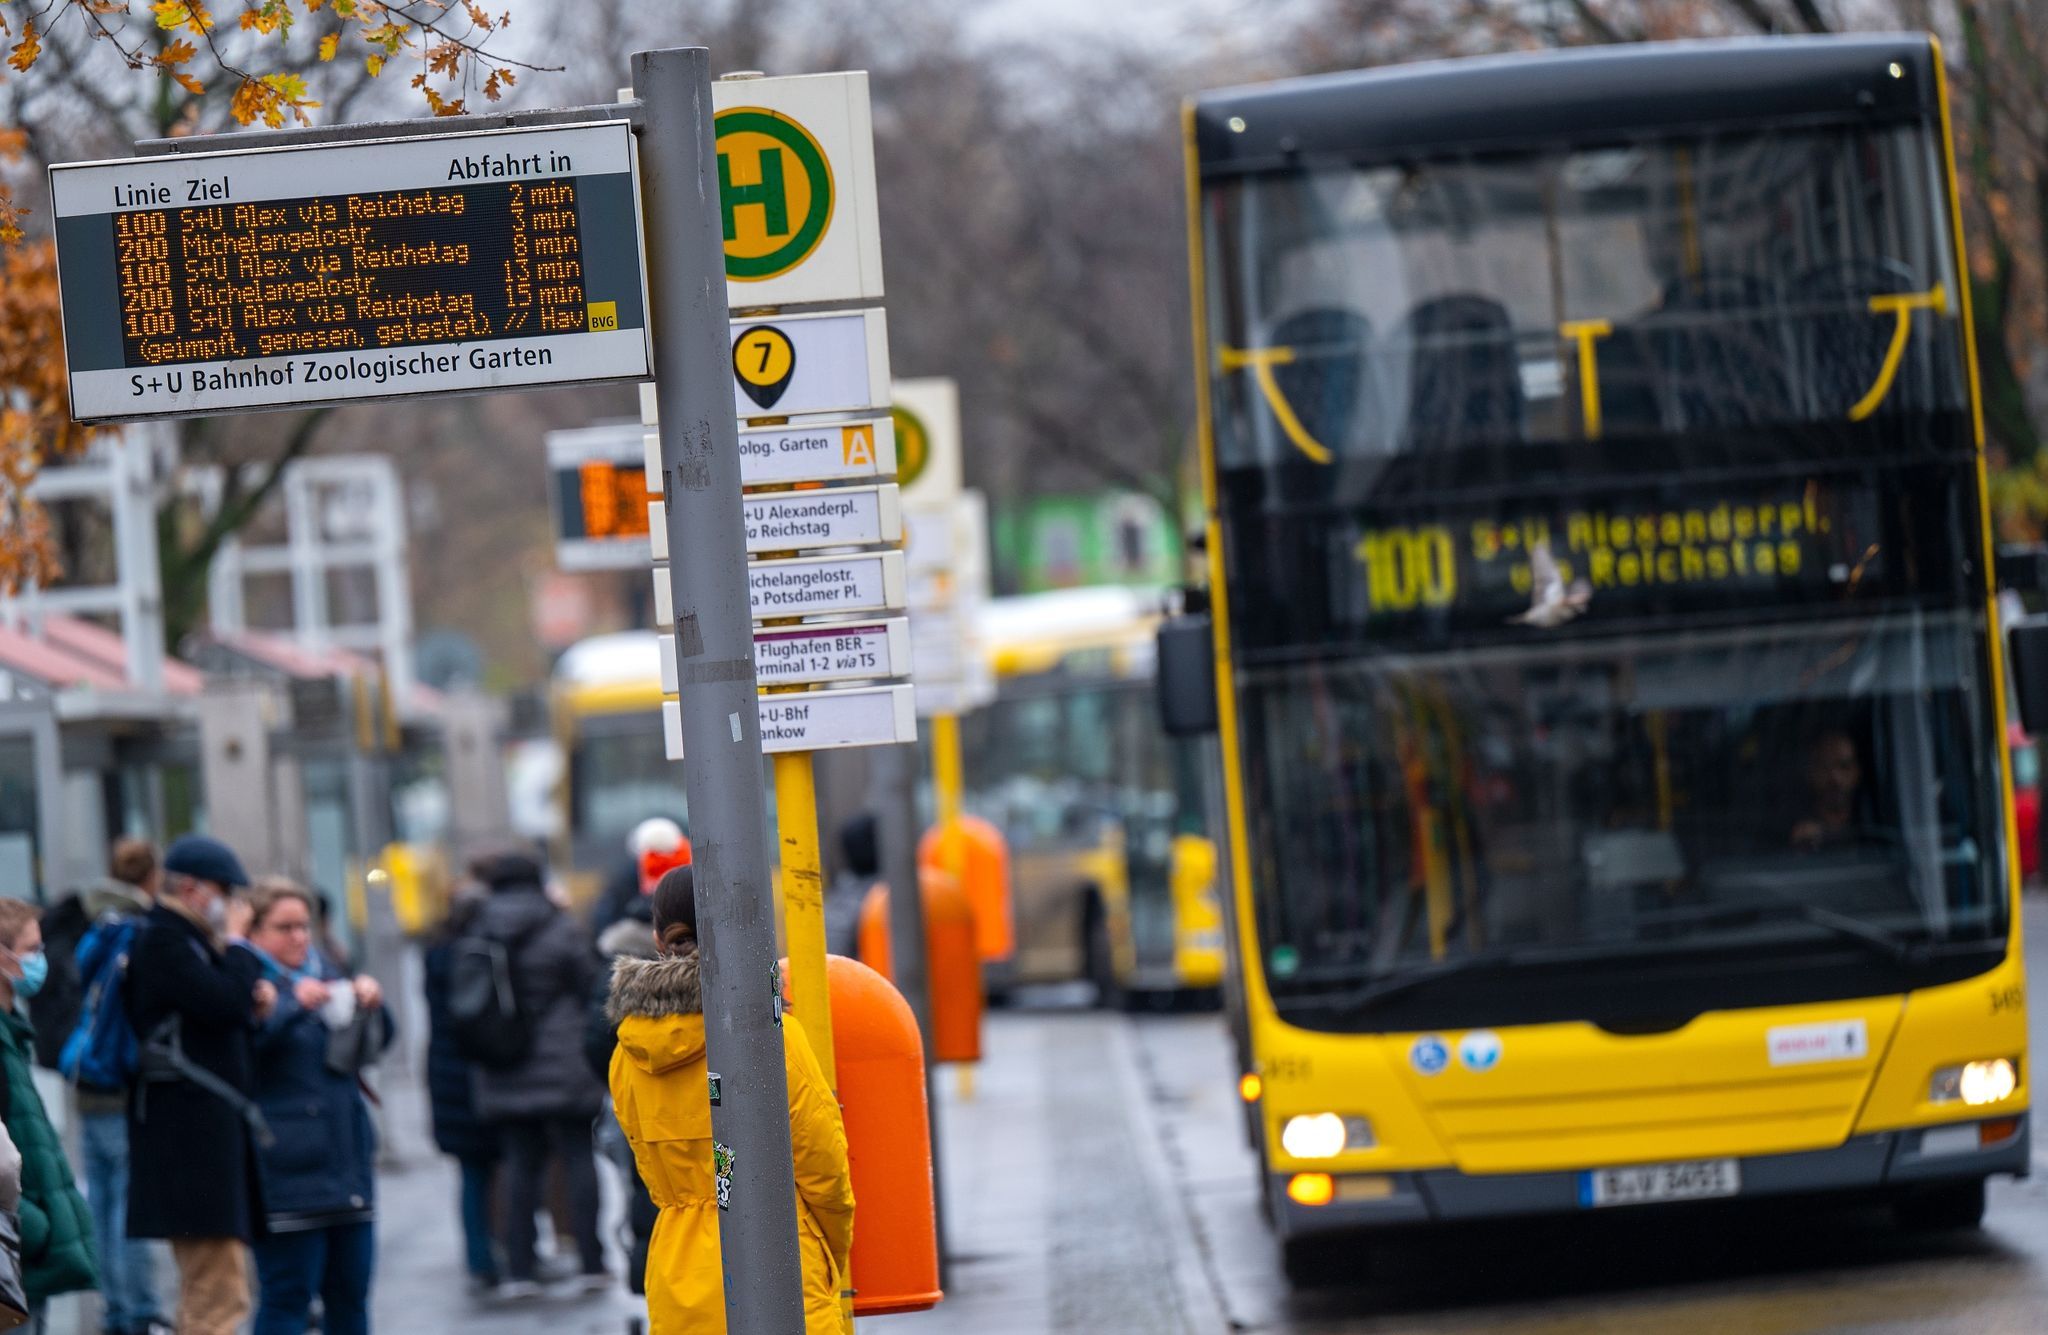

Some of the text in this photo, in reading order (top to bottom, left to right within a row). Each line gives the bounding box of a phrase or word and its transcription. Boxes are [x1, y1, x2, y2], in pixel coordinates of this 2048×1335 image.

[448, 150, 572, 180] Abfahrt in
[115, 176, 230, 207] Linie Ziel
[717, 148, 789, 241] H
[117, 180, 574, 237] 100 S+U Alex via Reichstag 2 min
[119, 206, 576, 262] 200 Michelangelostr. 3 min
[122, 231, 578, 287] 100 S+U Alex via Reichstag 8 min
[123, 256, 580, 312] 200 Michelangelostr. 13 min
[125, 281, 582, 337] 100 S+U Alex via Reichstag 15 min
[591, 316, 614, 329] BVG
[140, 332, 246, 364] (geimpft,
[258, 327, 364, 356] genesen,
[541, 307, 584, 330] Hav
[131, 347, 553, 396] S+U Bahnhof Zoologischer Garten
[753, 342, 772, 373] 7
[739, 431, 876, 466] olog. Garten A
[744, 499, 858, 522] +U Alexanderpl.
[745, 522, 830, 540] ia Reichstag
[1360, 525, 1457, 611] 100
[1567, 498, 1831, 553] Alexanderpl.
[1589, 540, 1801, 588] Reichstag
[751, 569, 854, 589] ichelangelostr.
[764, 588, 839, 606] Potsdamer
[844, 585, 861, 600] Pl.
[760, 639, 831, 660] Flughafen
[835, 637, 862, 652] BER
[810, 657, 830, 671] 1-2
[836, 655, 857, 669] via
[860, 653, 876, 668] T5
[760, 705, 809, 722] +U-Bhf
[760, 725, 806, 741] ankow
